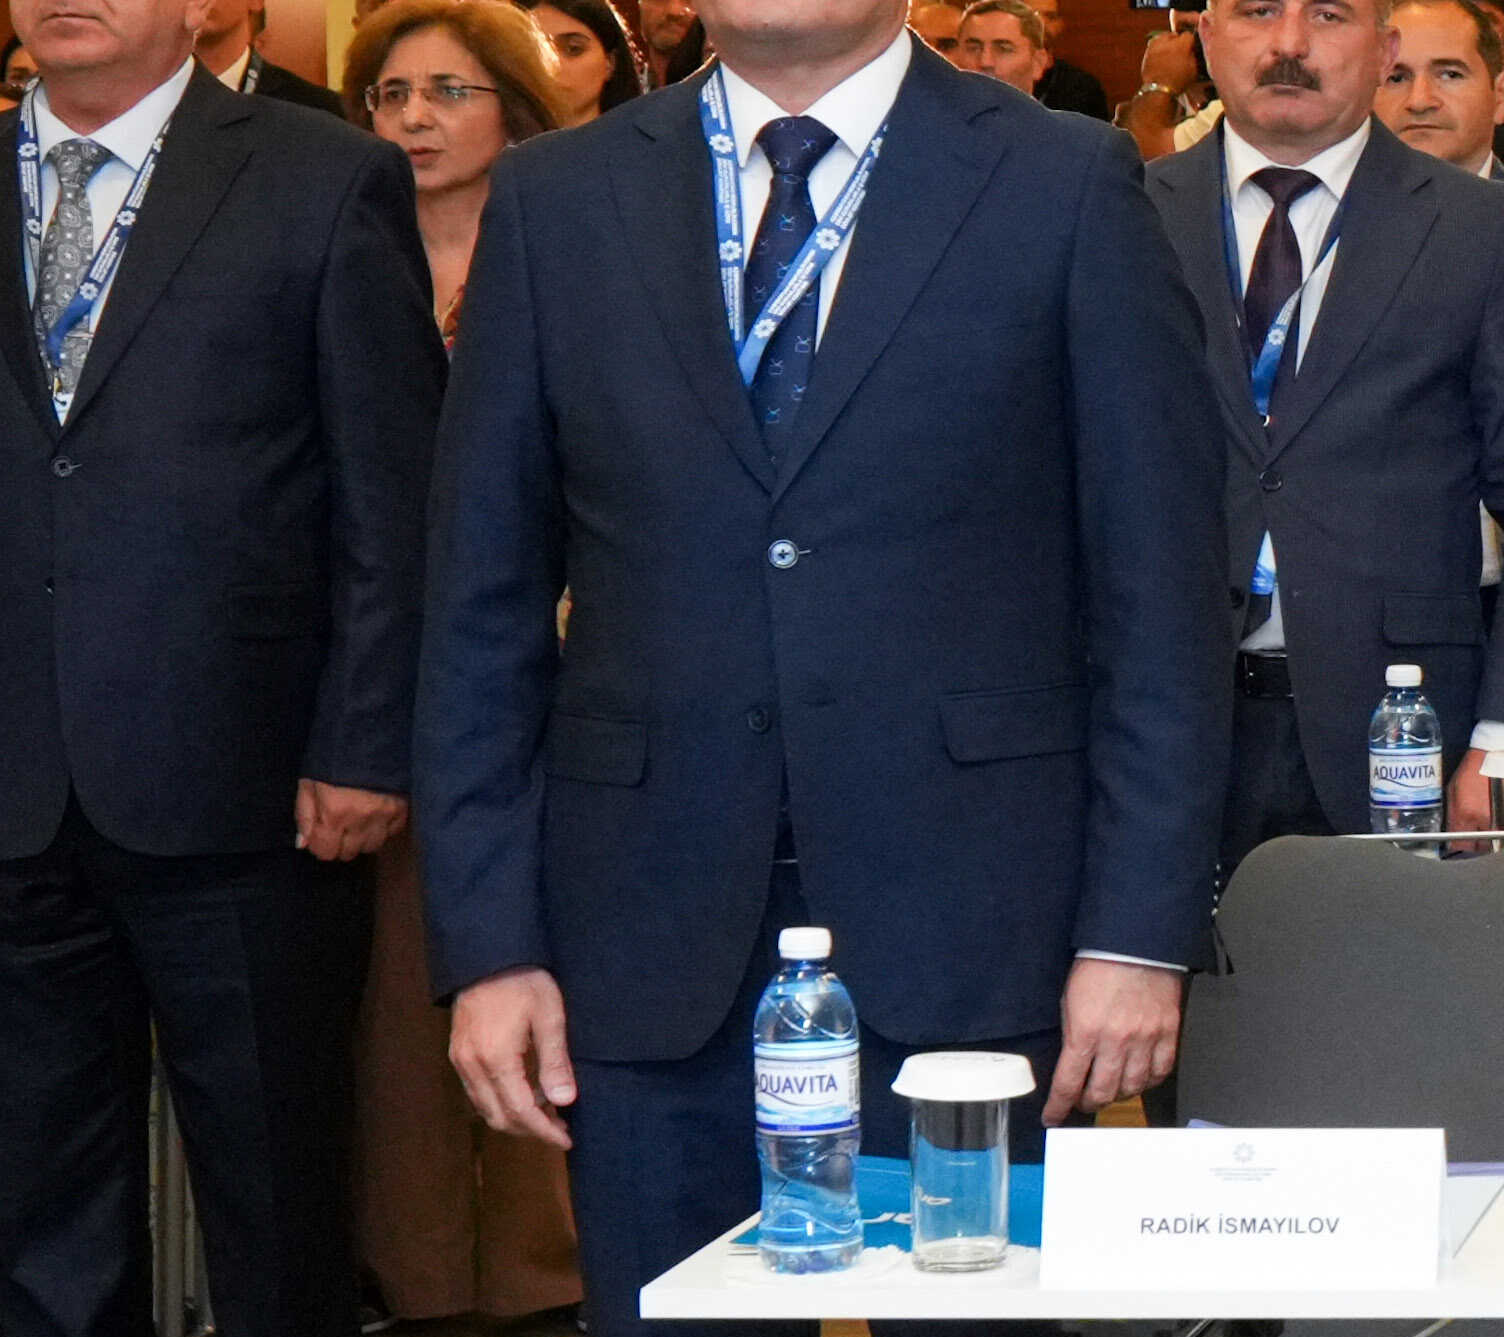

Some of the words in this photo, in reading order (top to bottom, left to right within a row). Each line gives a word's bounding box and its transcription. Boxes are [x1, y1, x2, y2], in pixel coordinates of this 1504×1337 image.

[1373, 765, 1435, 779] AQUAVITA
[1139, 1213, 1211, 1235] RADİK
[1217, 1213, 1341, 1235] İSMAYILOV
